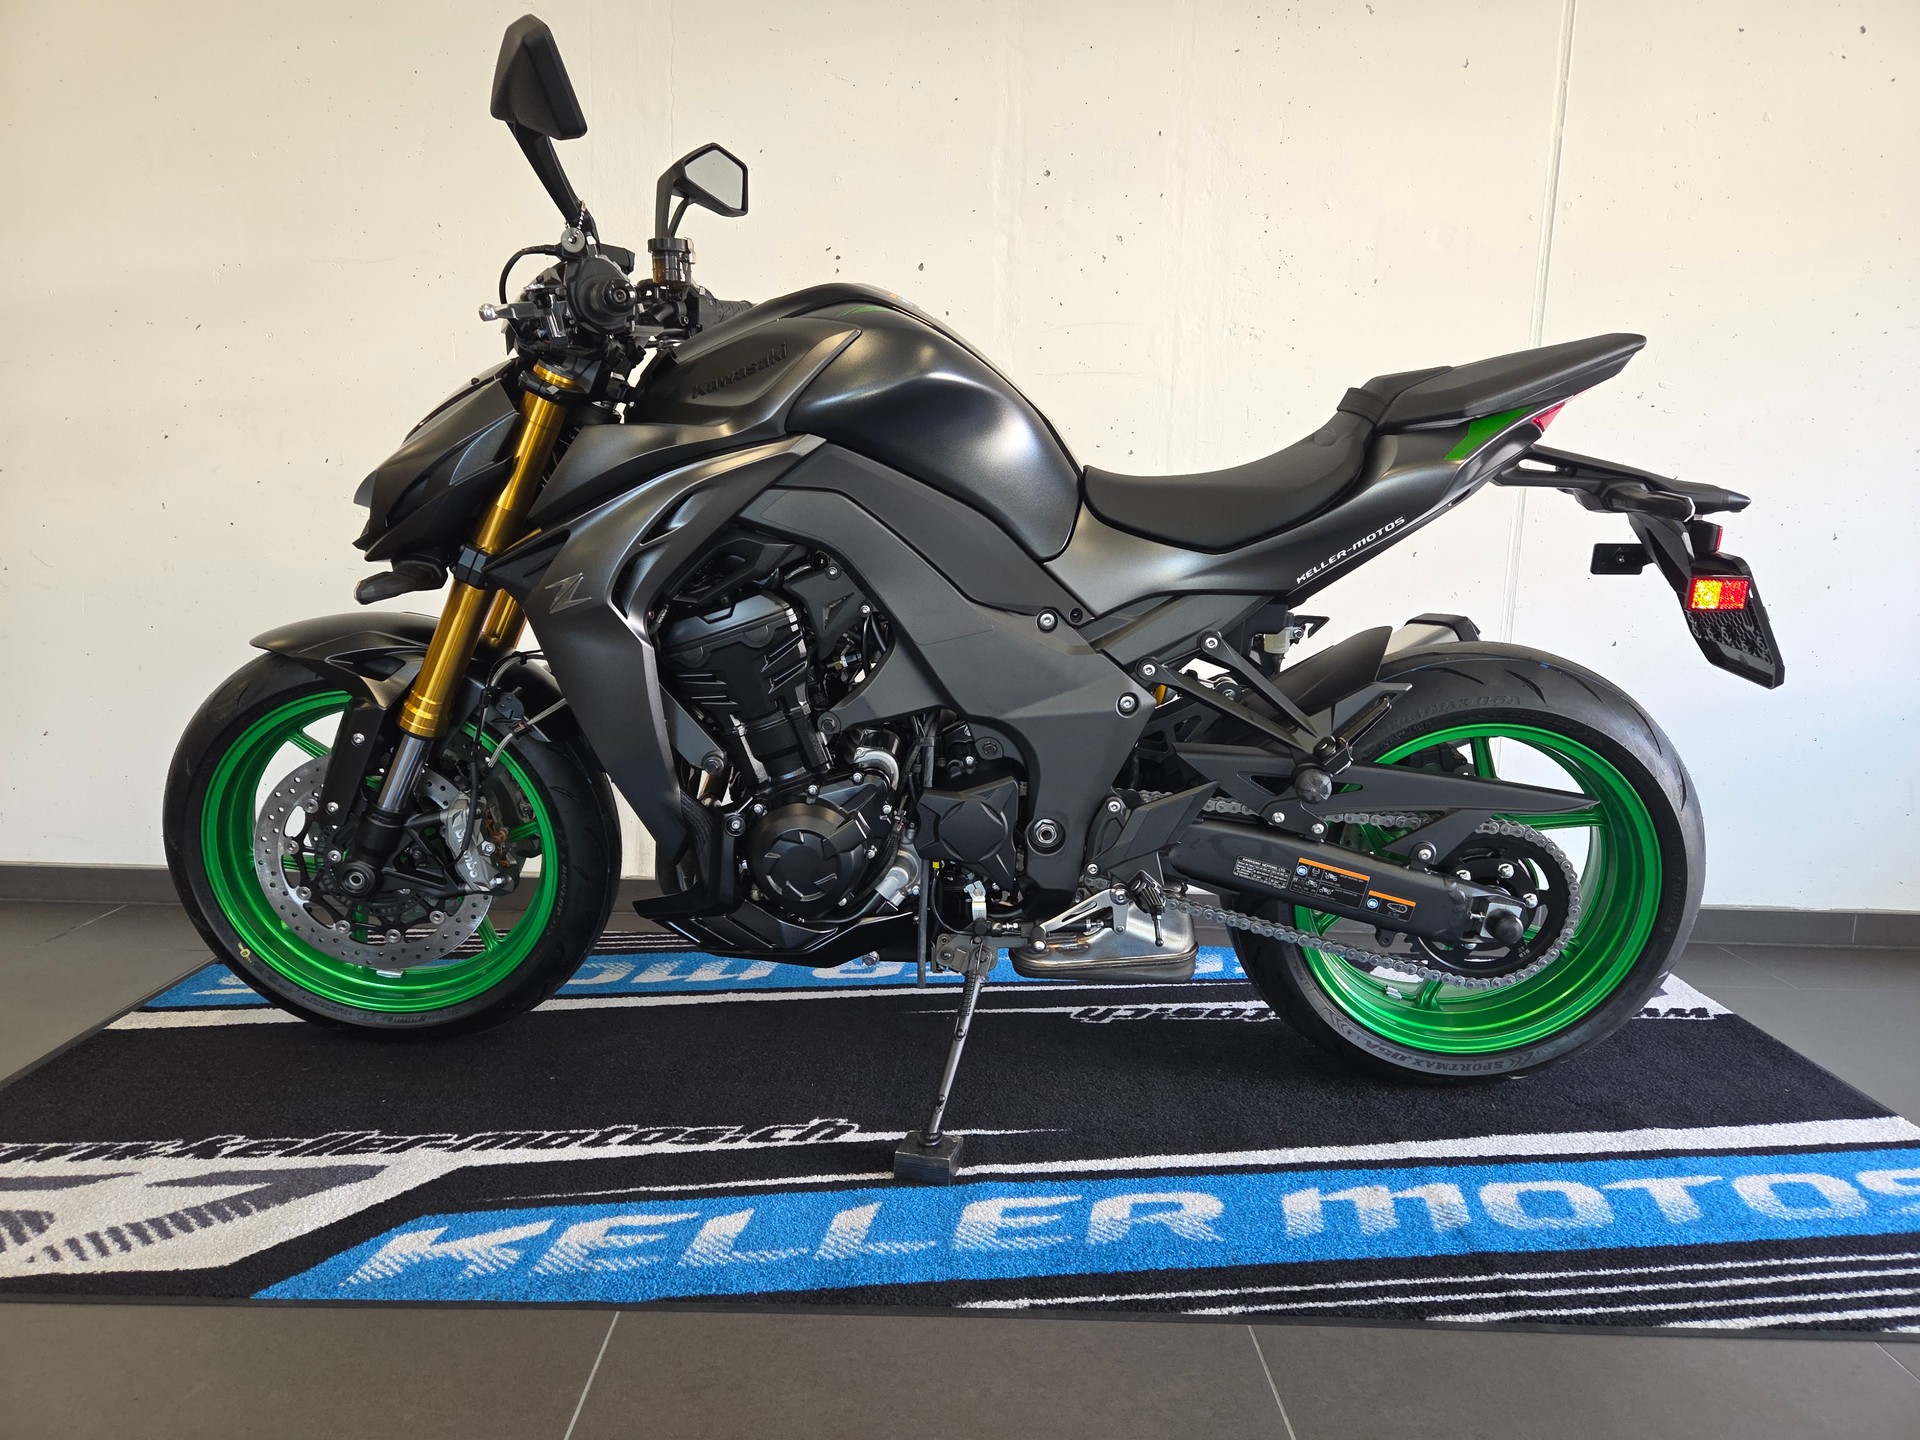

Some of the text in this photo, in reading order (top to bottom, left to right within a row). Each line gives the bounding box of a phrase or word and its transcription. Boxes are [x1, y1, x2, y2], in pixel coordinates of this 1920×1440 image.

[691, 342, 787, 400] Kawasaki
[1296, 515, 1406, 585] KELLER-MOTOS
[1413, 1057, 1504, 1073] SPORTMAX
[338, 1190, 1225, 1288] KELLER
